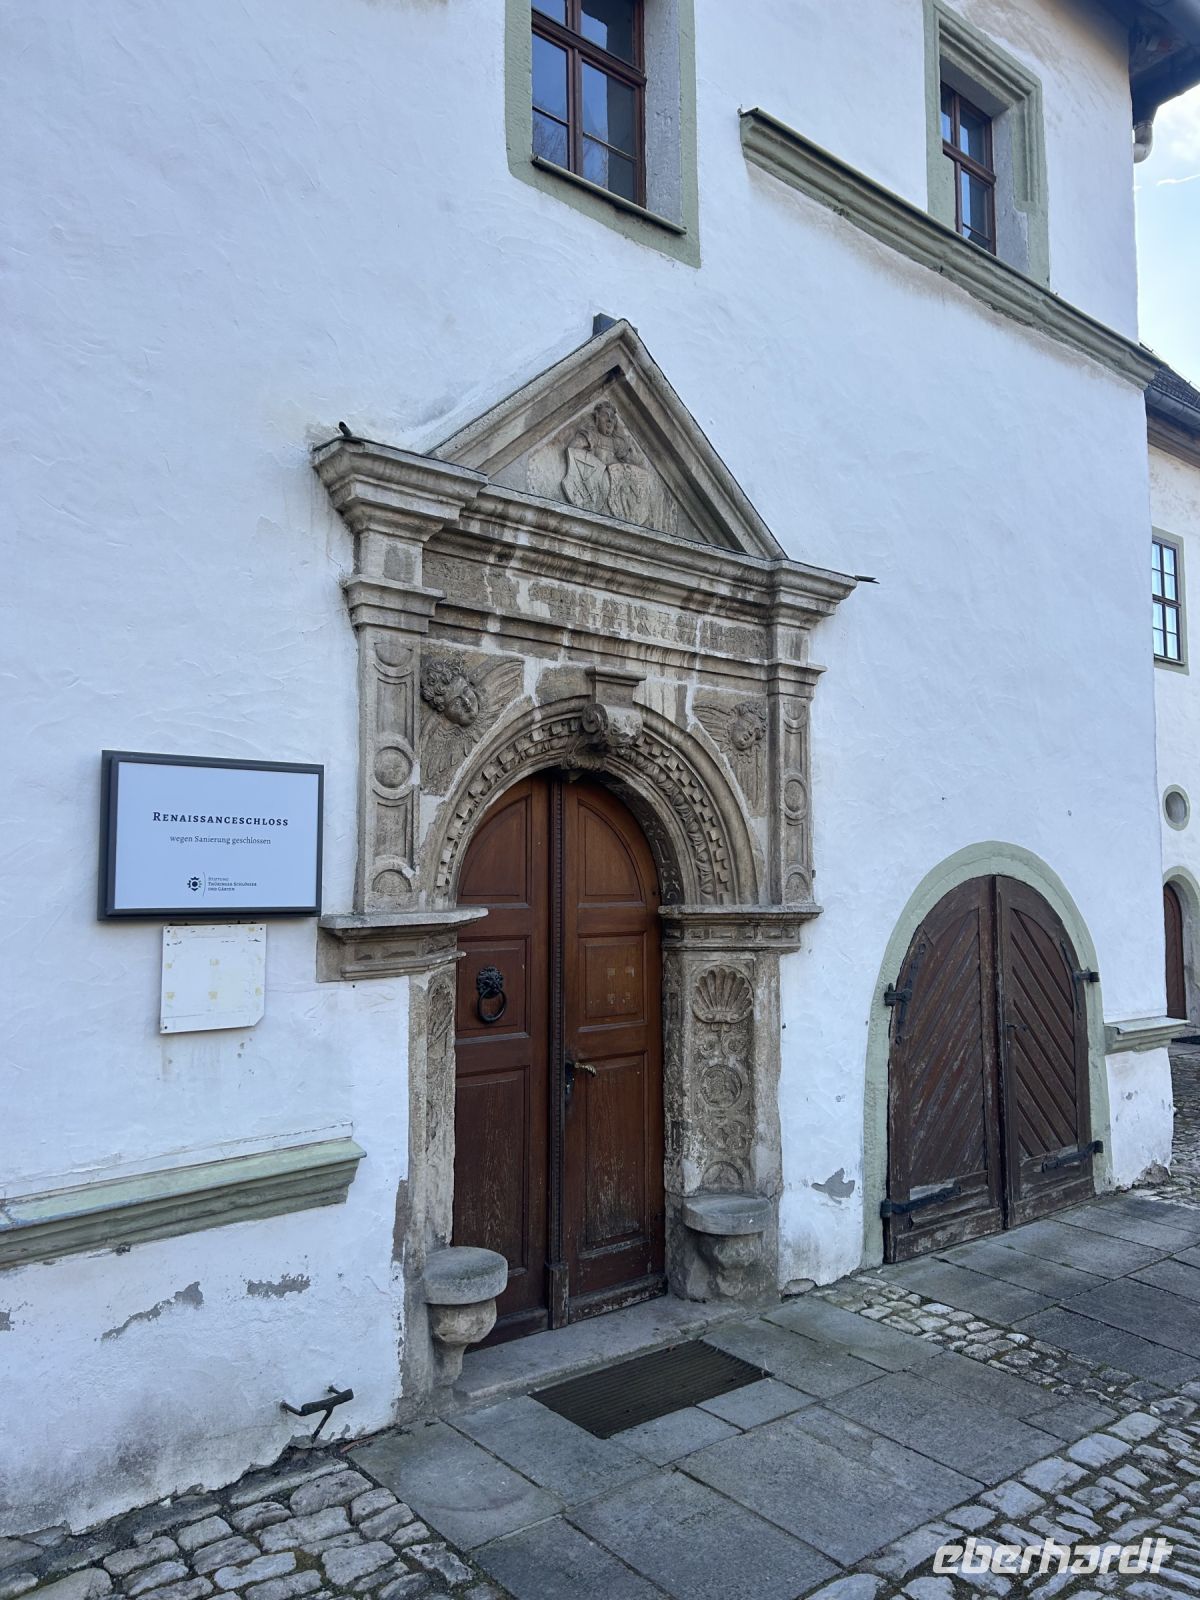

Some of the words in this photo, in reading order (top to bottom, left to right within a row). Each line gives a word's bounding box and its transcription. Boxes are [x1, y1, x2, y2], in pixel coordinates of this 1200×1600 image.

[153, 811, 289, 826] RENAISSANCESCHLOSS
[170, 835, 193, 844] wegen
[194, 835, 230, 845] Sanierung
[231, 836, 271, 845] geschlossen
